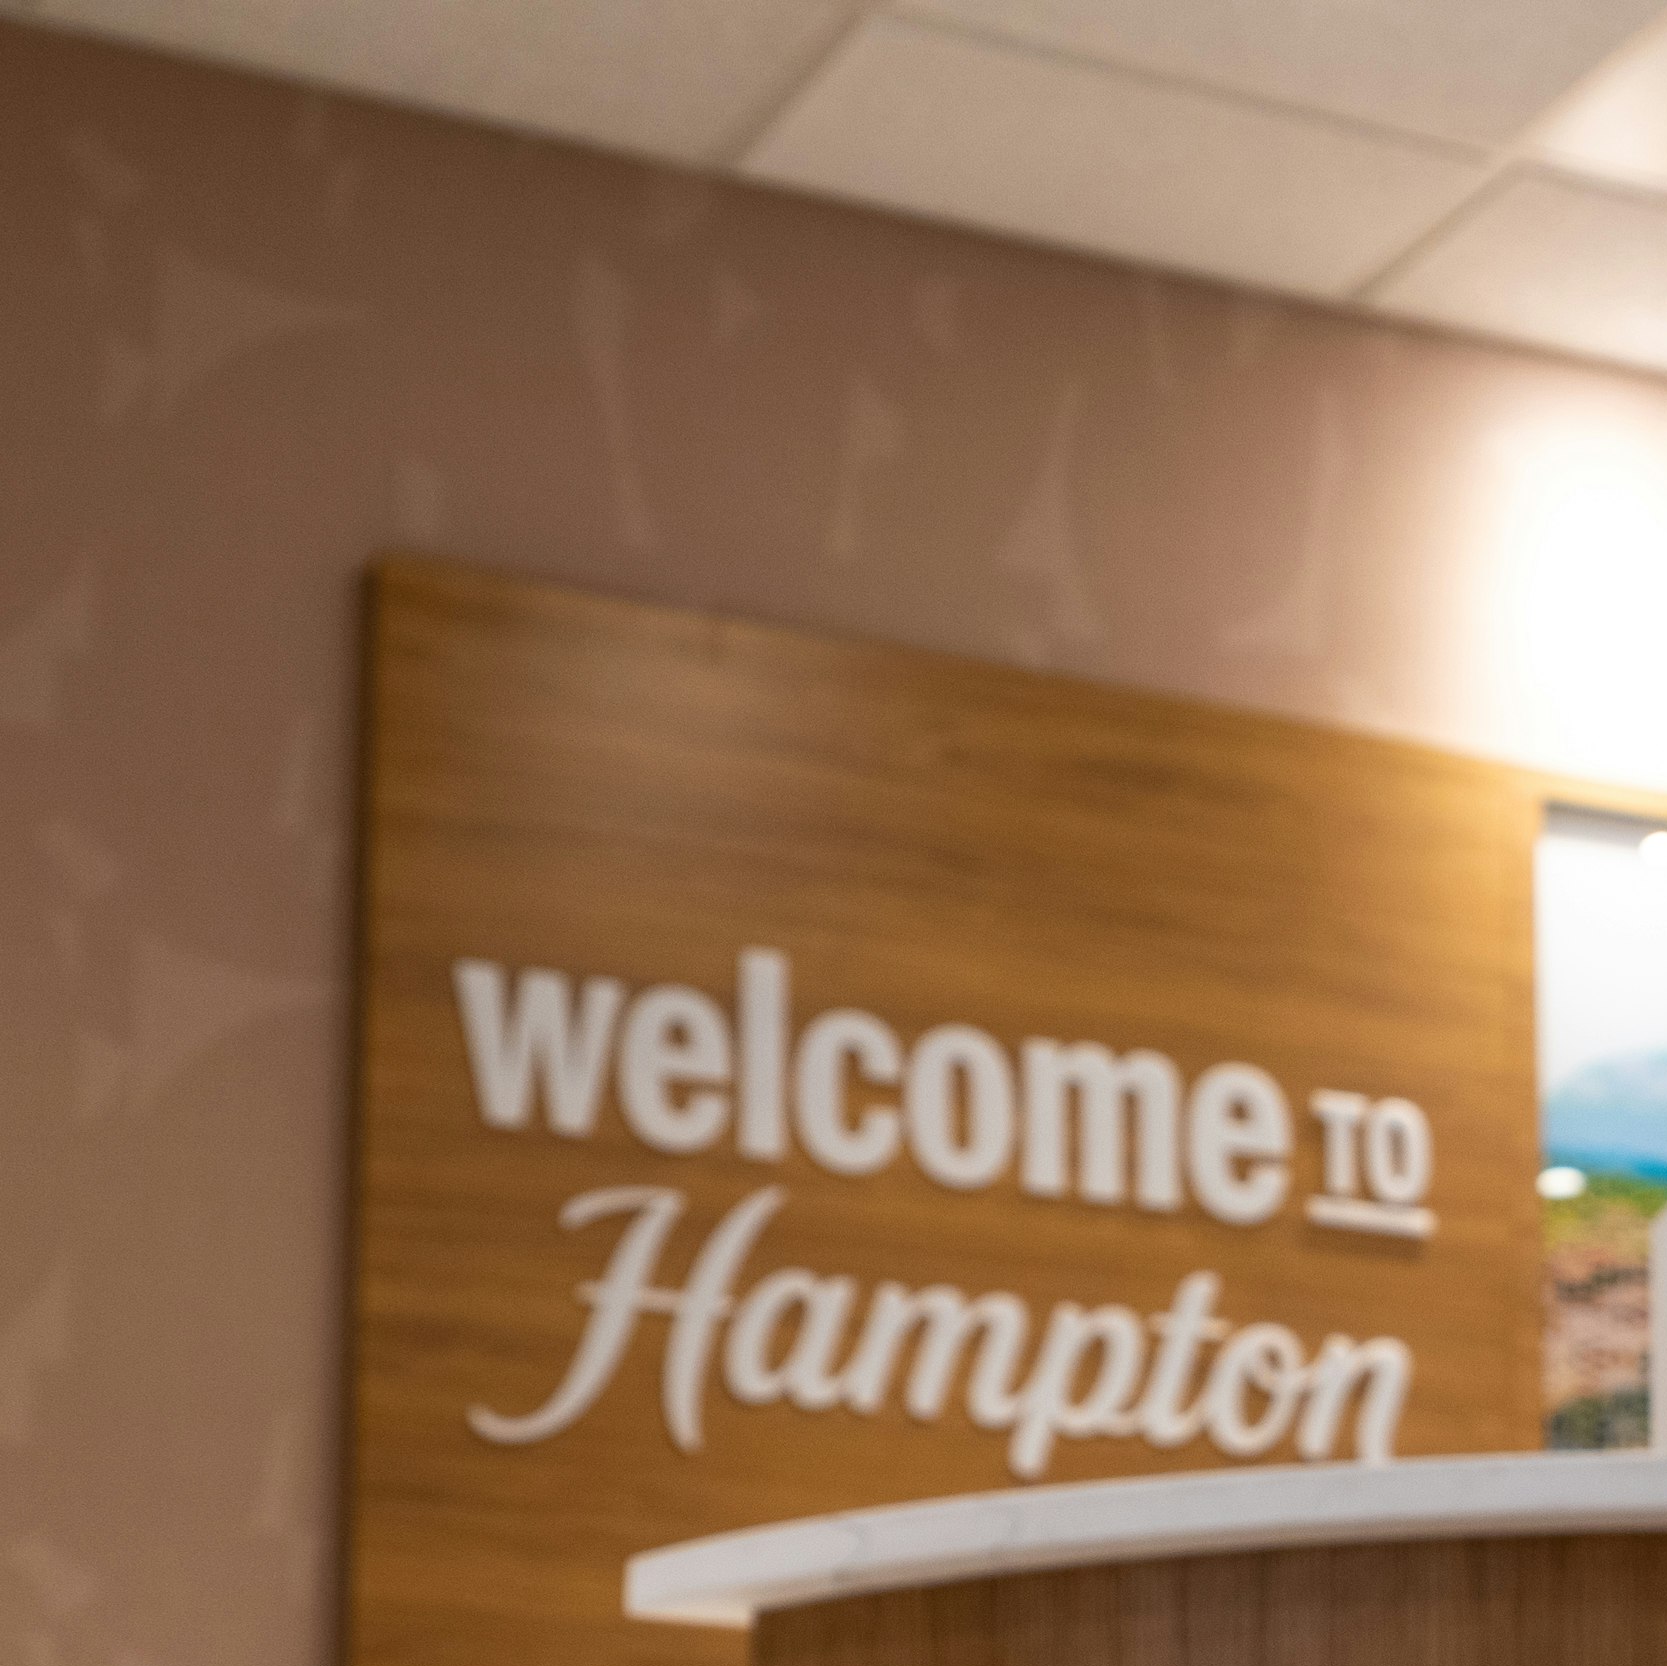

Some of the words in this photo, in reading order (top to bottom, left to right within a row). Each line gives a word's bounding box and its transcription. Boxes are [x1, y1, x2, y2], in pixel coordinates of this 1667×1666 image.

[451, 946, 1292, 1226] welcome
[1308, 1086, 1433, 1206] TO
[465, 1182, 1411, 1479] Hampton
